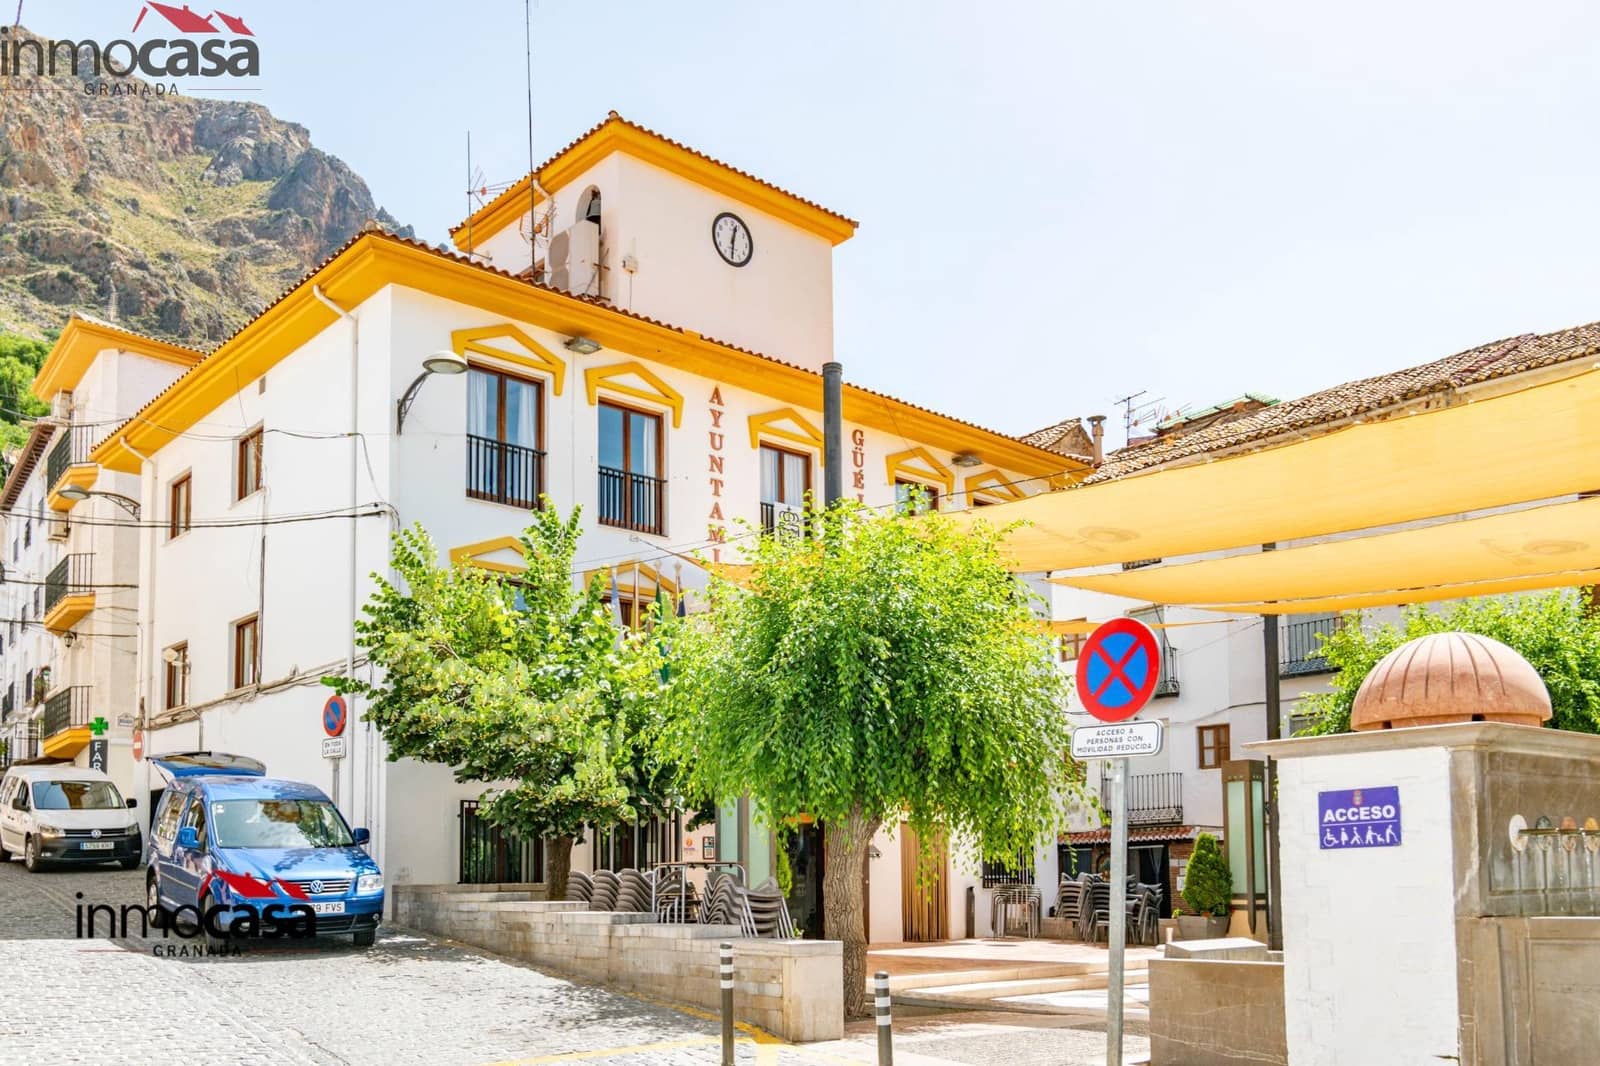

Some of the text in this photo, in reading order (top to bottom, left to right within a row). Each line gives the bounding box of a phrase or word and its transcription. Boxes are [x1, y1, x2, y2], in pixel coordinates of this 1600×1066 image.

[709, 385, 727, 564] AYUNTAMI
[1096, 728, 1126, 736] ACCESO
[1086, 736, 1123, 745] PERSONAS
[1116, 743, 1152, 751] REDUCIDA
[92, 741, 102, 771] FAR
[1323, 804, 1396, 823] ACCESO
[325, 903, 342, 912] FVS
